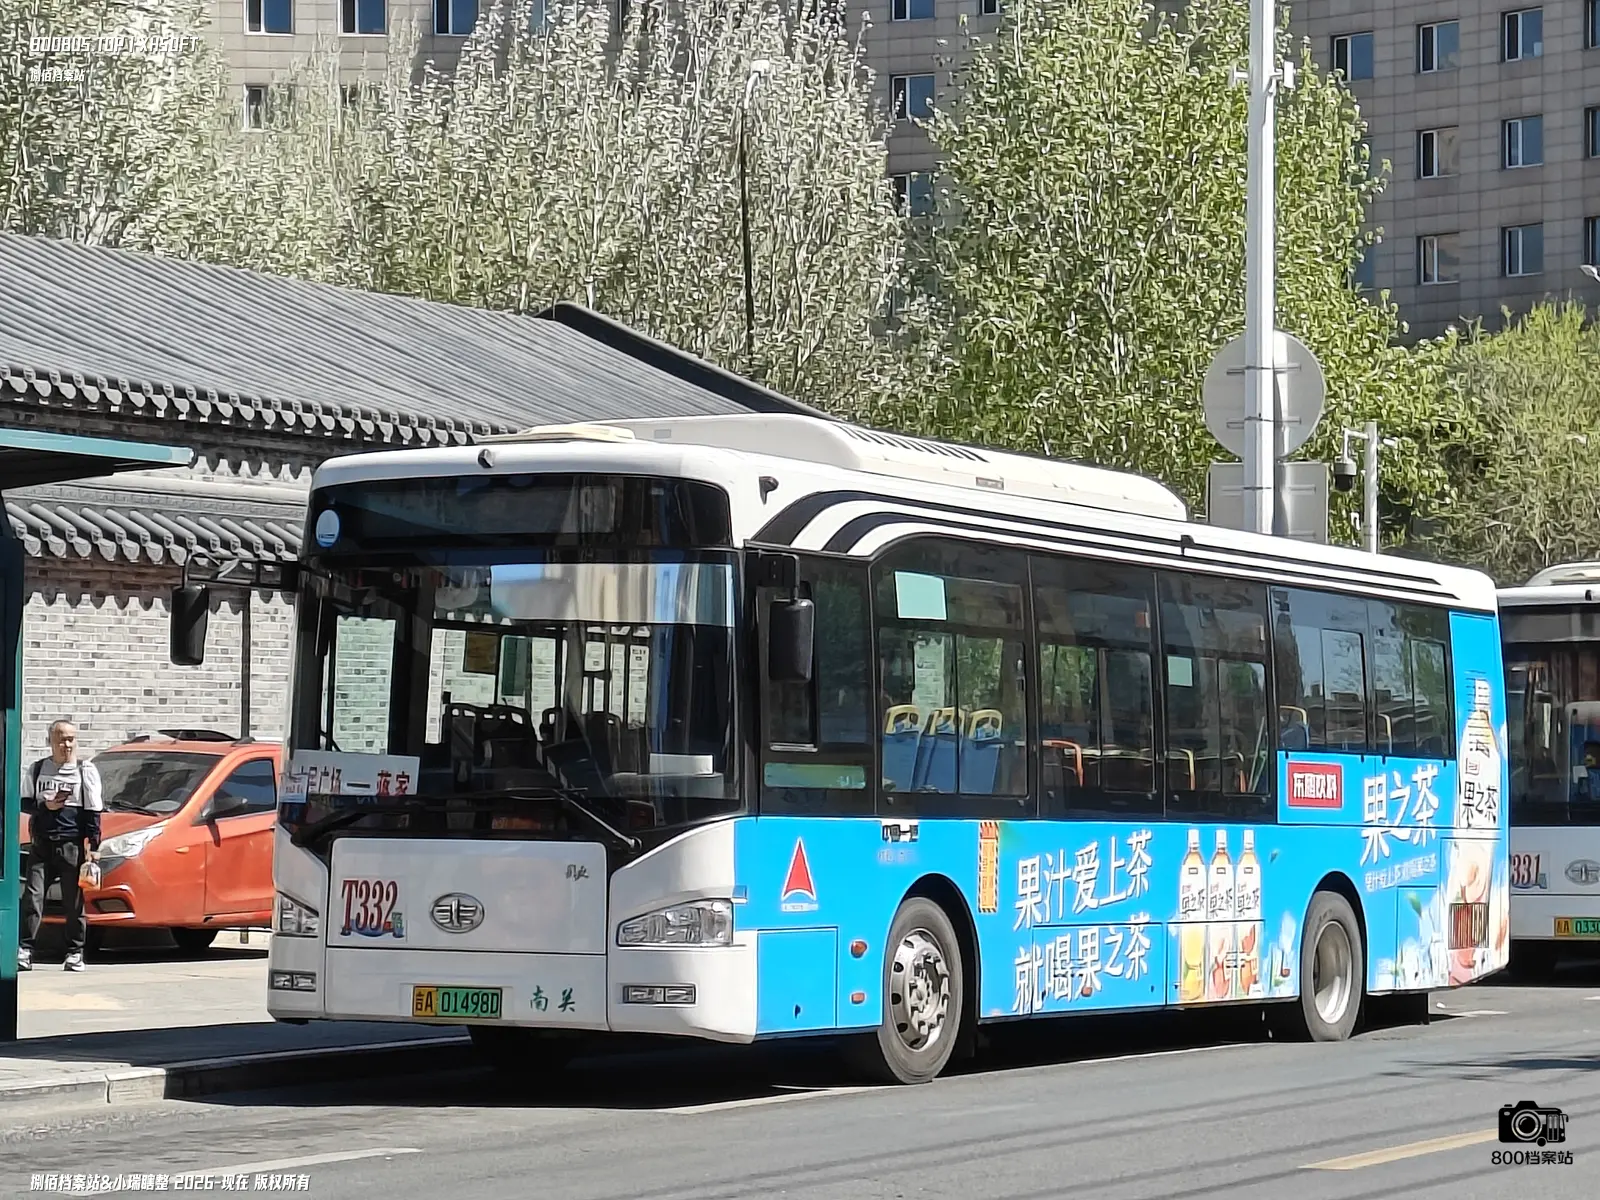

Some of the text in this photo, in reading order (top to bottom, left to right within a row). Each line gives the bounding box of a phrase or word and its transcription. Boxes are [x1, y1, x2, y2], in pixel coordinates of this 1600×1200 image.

[1359, 764, 1440, 868] 果之茶
[1013, 829, 1153, 931] 果汁爱上茶
[1012, 912, 1151, 1015] 就喝果之茶
